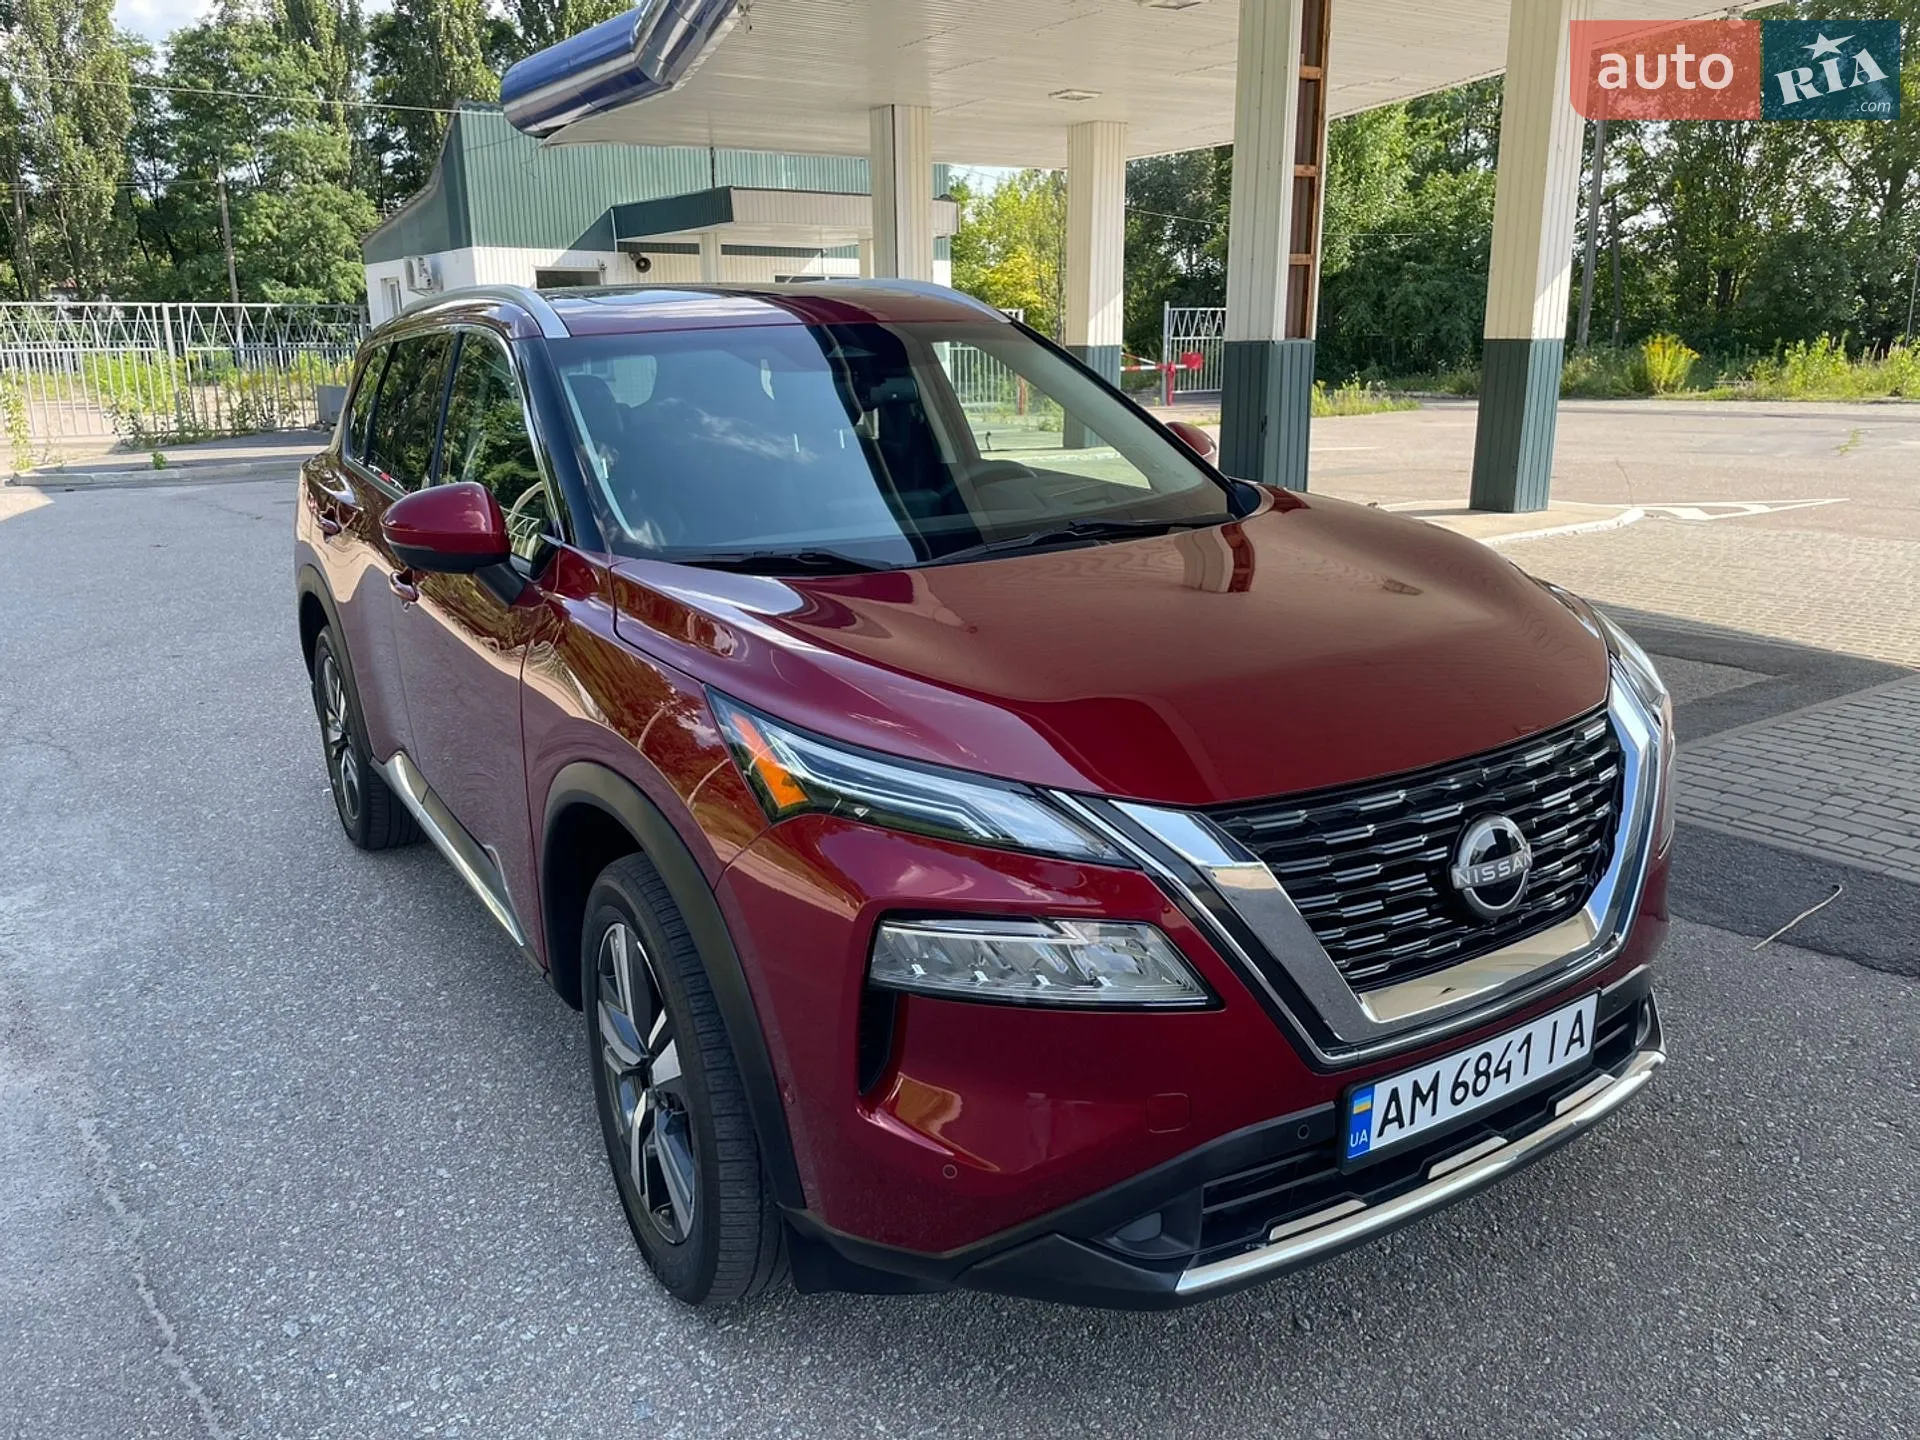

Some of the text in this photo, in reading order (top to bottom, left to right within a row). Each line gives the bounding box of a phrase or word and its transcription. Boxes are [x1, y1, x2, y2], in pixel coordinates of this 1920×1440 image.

[1455, 851, 1532, 885] NISSAN
[1377, 1009, 1585, 1138] AM 6841 IA
[1350, 1129, 1368, 1148] UA
